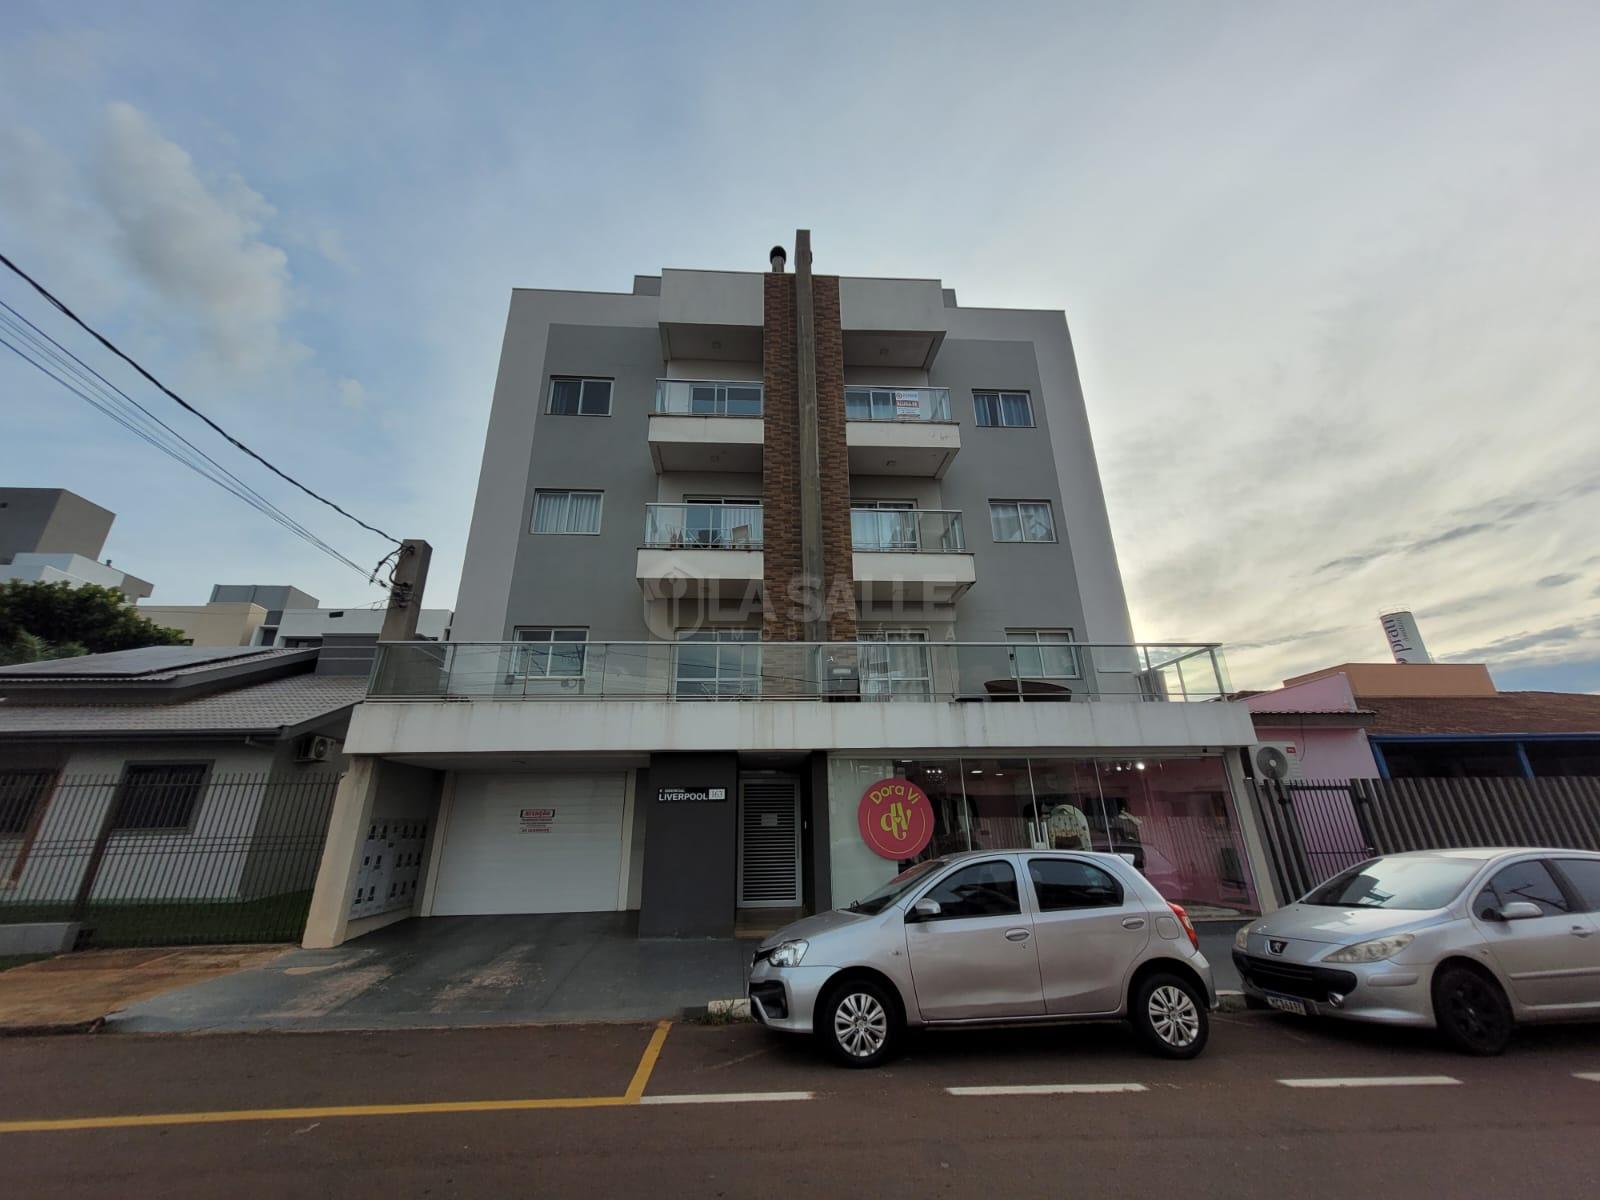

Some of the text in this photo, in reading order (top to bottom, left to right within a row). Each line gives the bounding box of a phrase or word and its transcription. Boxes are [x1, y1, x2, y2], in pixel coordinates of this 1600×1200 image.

[658, 792, 708, 801] LIVERPOOL
[869, 785, 921, 804] Dora Vi
